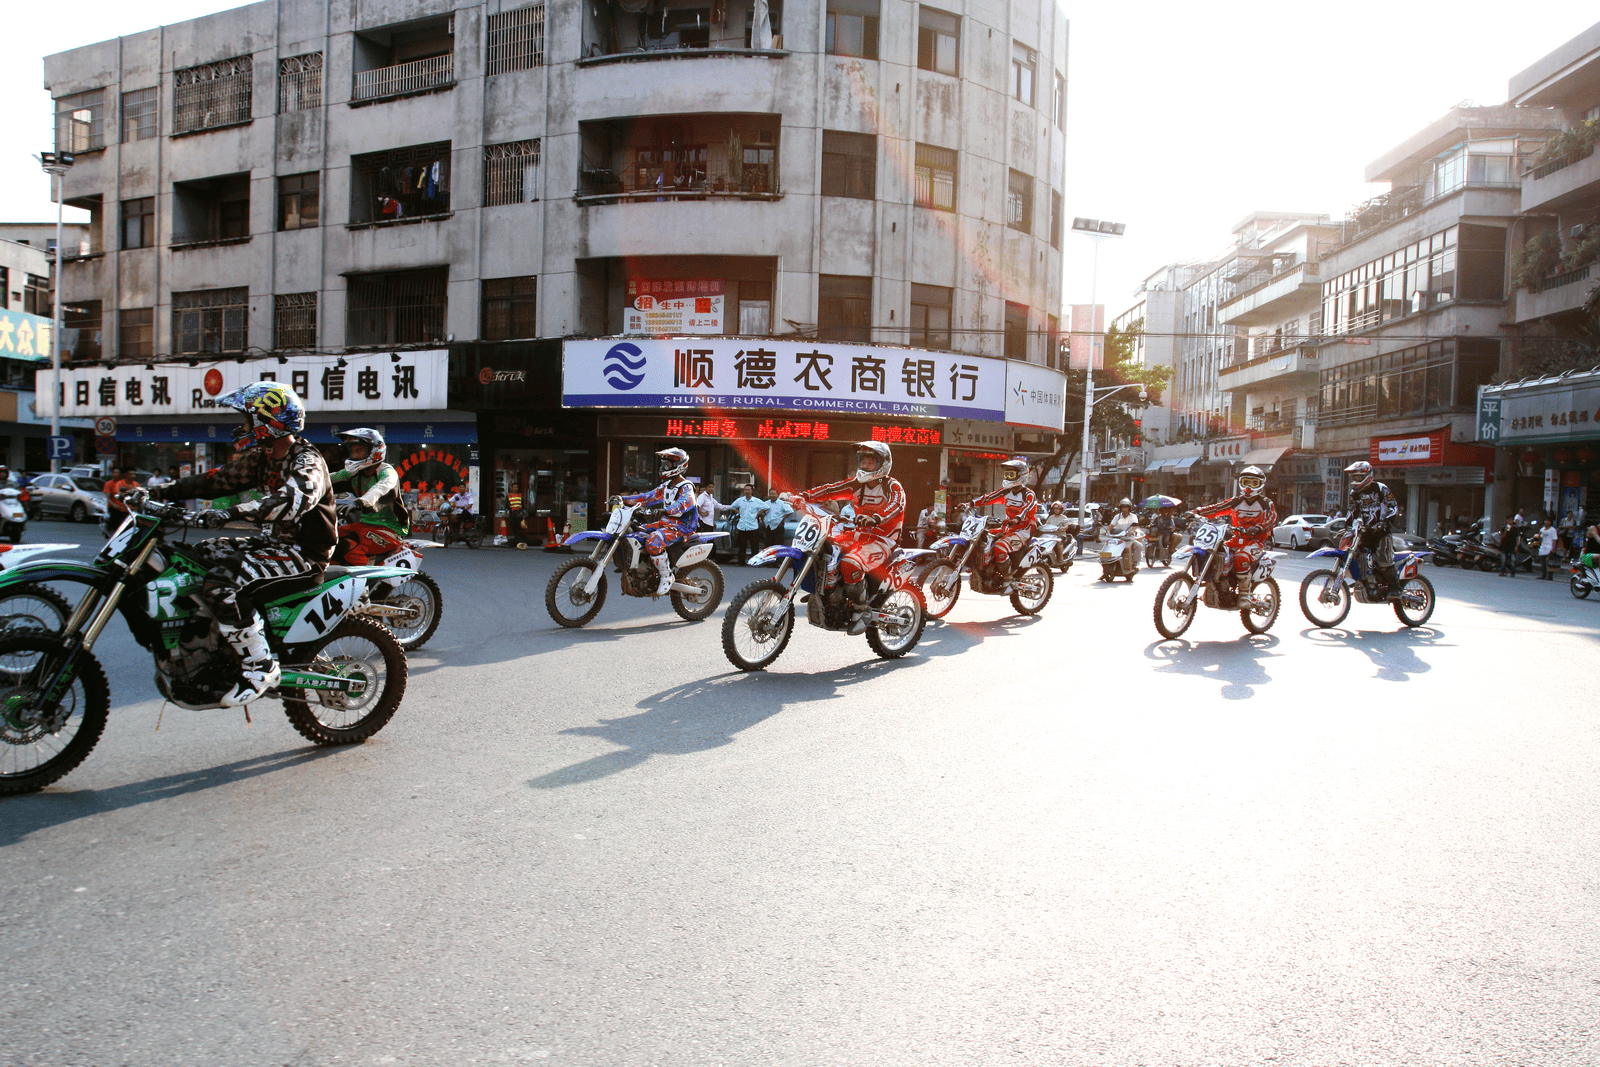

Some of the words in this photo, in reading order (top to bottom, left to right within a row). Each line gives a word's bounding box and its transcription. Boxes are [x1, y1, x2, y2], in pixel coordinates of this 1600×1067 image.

[673, 348, 979, 401] 顺德农商银行
[663, 396, 726, 405] SHUNDE
[733, 396, 785, 406] RURAL
[792, 398, 887, 411] COMMERCIAL
[892, 403, 927, 413] BANK
[100, 422, 112, 431] 30
[1482, 400, 1499, 440] 平价
[52, 438, 71, 458] P
[794, 521, 819, 542] 26
[961, 520, 979, 535] 24
[1195, 528, 1218, 544] 25
[1258, 563, 1272, 579] 25
[303, 591, 344, 635] 14
